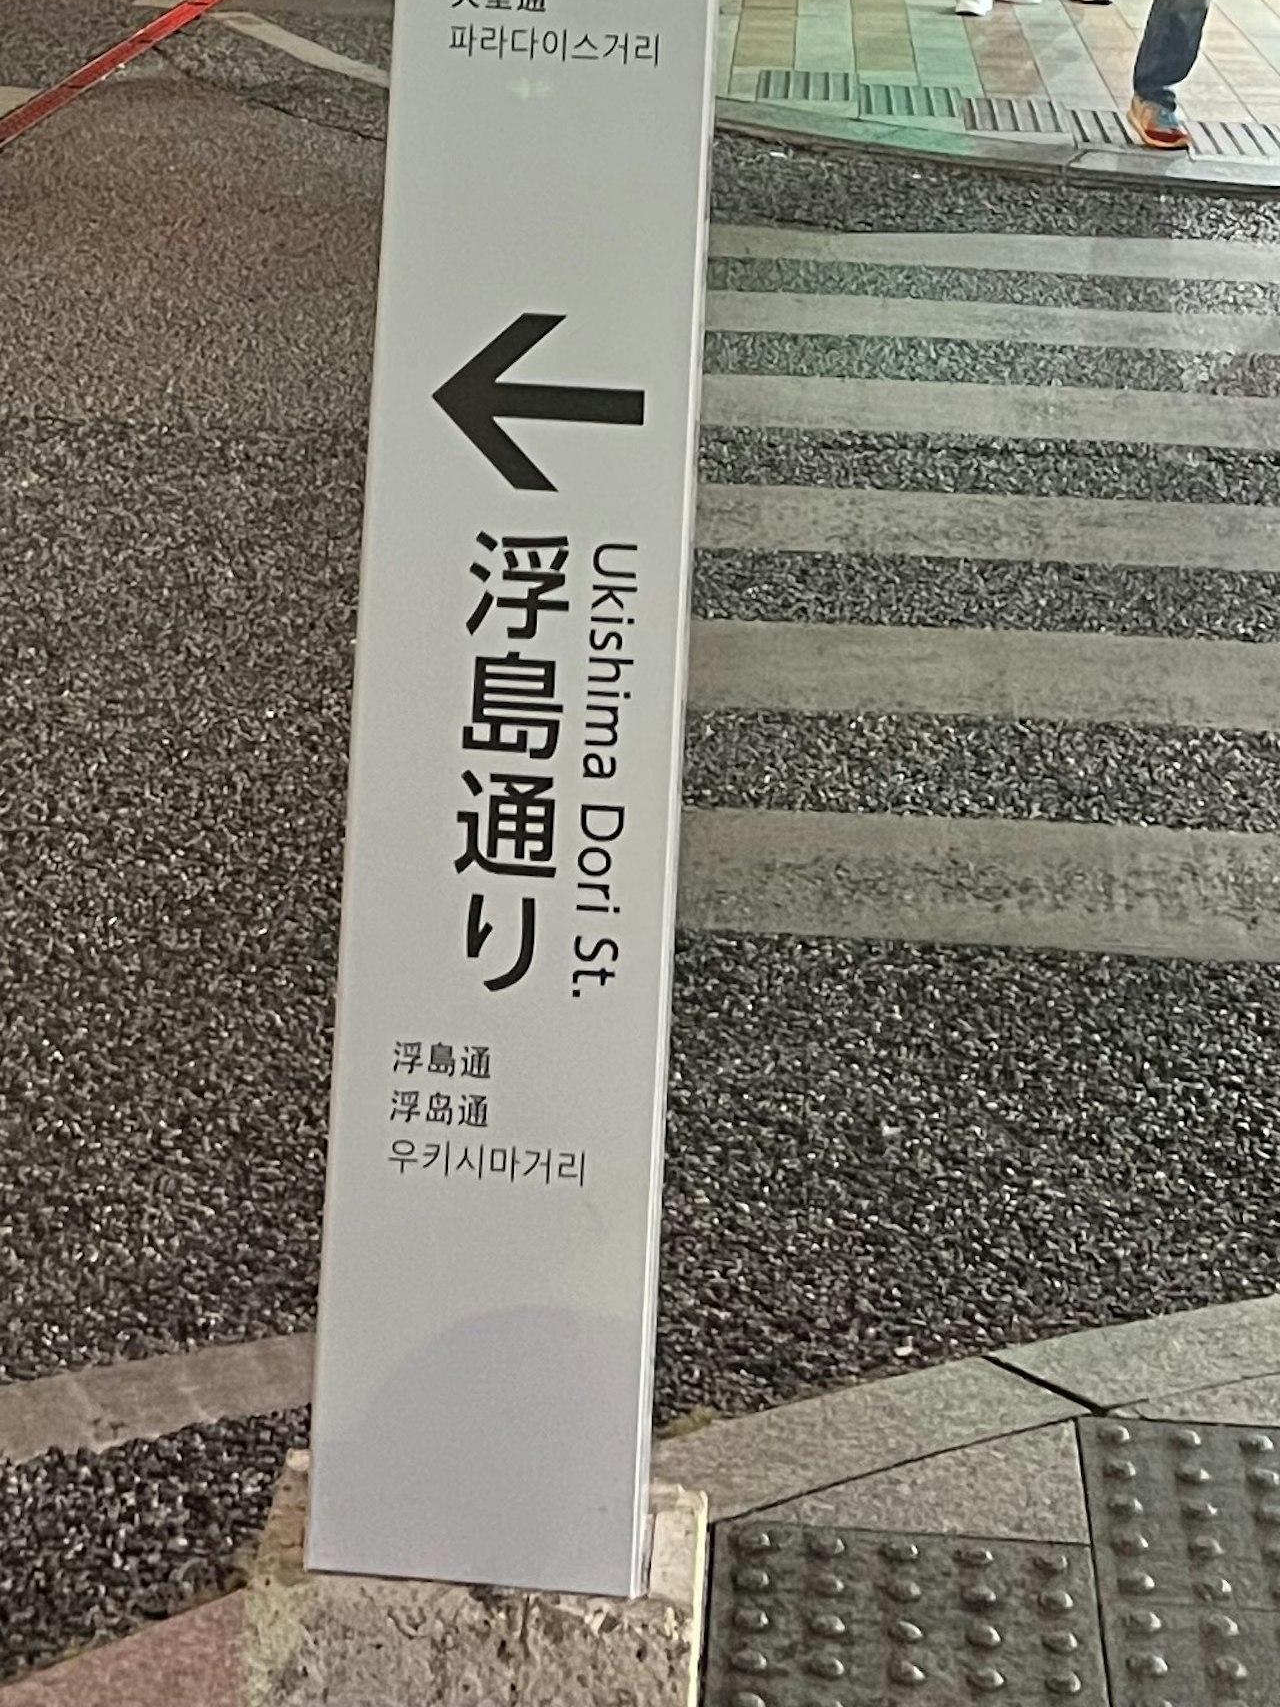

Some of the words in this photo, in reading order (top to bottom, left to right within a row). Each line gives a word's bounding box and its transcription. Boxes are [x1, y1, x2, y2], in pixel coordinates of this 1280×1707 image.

[449, 23, 660, 67] 파라다이스거리
[582, 544, 638, 779] Ukishima
[454, 531, 570, 992] 浮島通り
[576, 804, 624, 913] Dori
[572, 935, 619, 998] St.
[393, 1041, 490, 1079] 浮島通
[390, 1090, 488, 1127] 浮岛通
[388, 1139, 585, 1187] 우키시마거리
